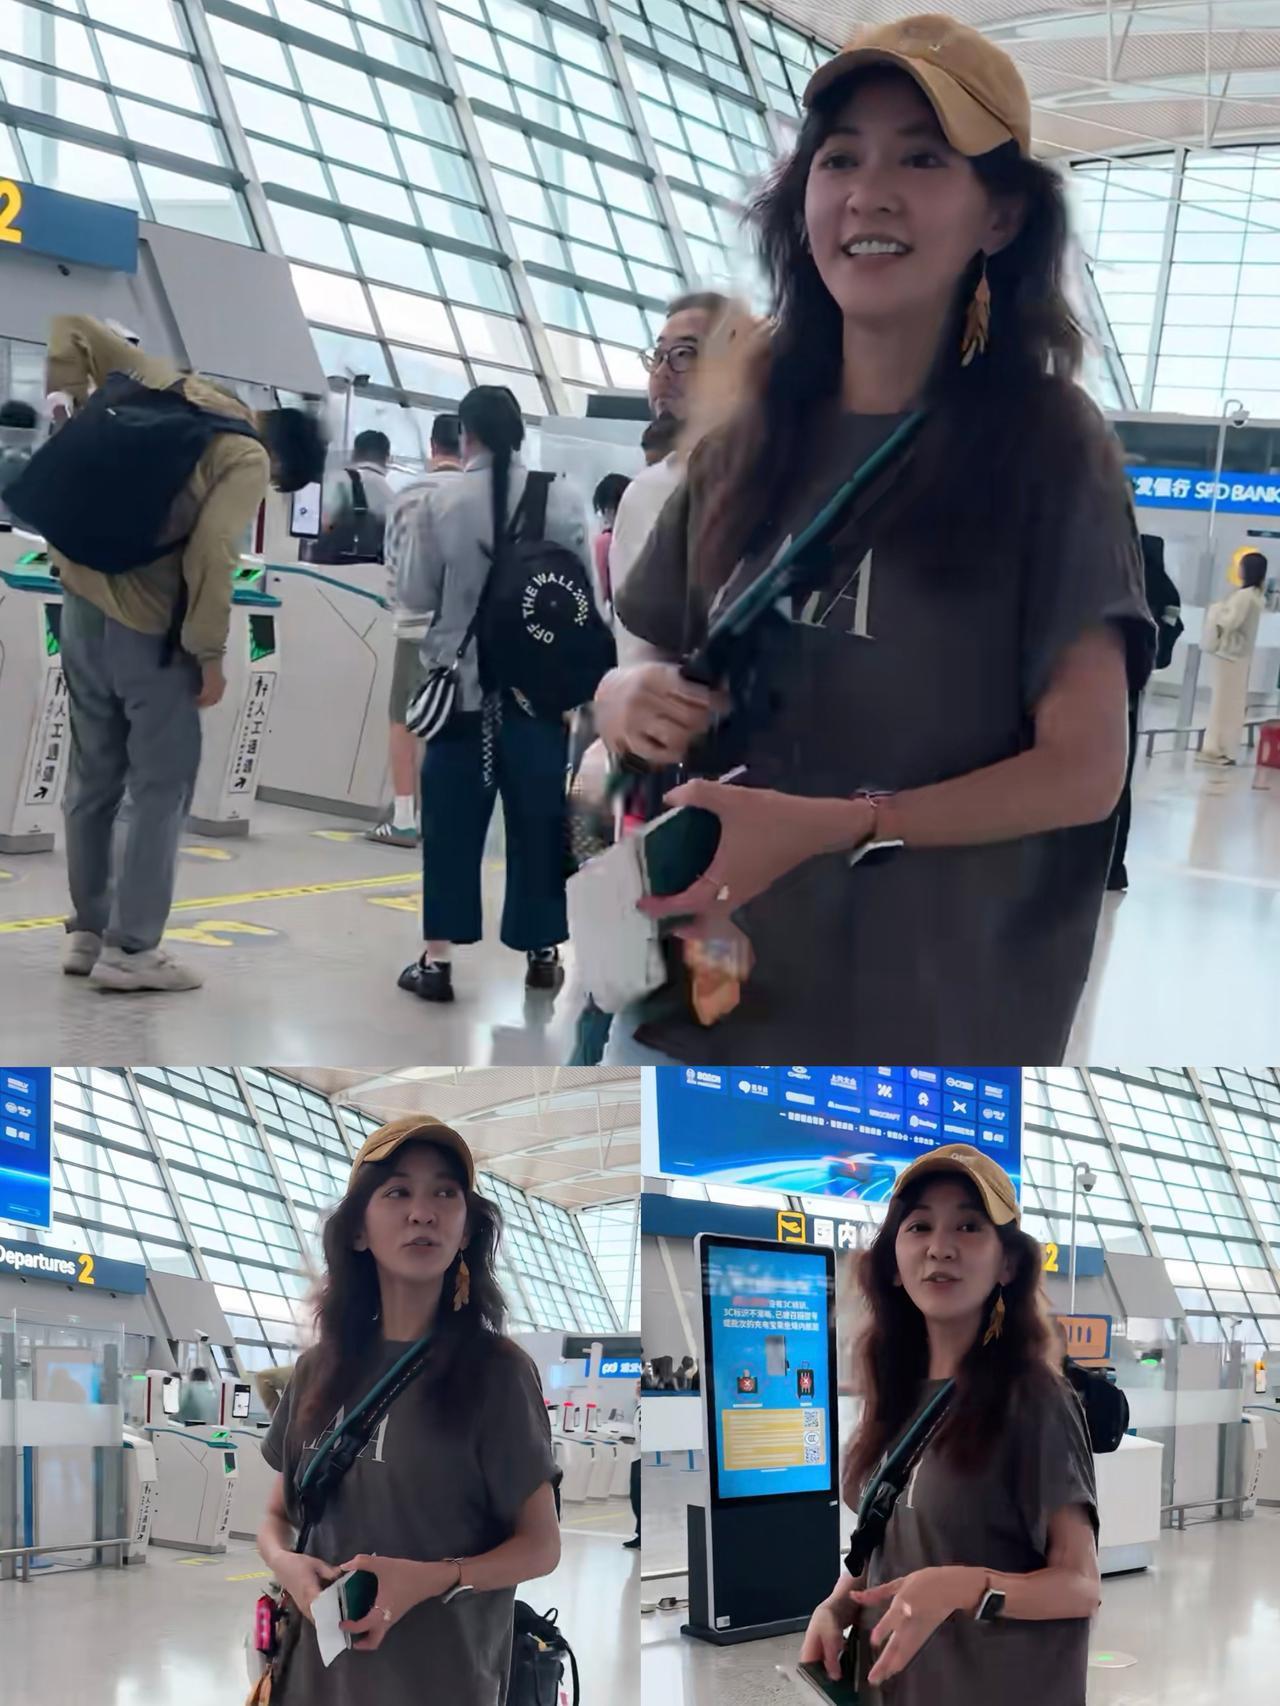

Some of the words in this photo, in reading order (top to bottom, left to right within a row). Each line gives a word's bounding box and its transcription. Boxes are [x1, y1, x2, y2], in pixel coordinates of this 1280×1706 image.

[0, 178, 22, 244] 2
[1231, 484, 1280, 502] BANK
[532, 572, 574, 591] WALL
[522, 585, 538, 619] THE
[526, 623, 554, 643] OFF
[813, 1218, 872, 1249] 国内
[77, 1254, 95, 1285] 2
[1042, 1243, 1059, 1272] 2
